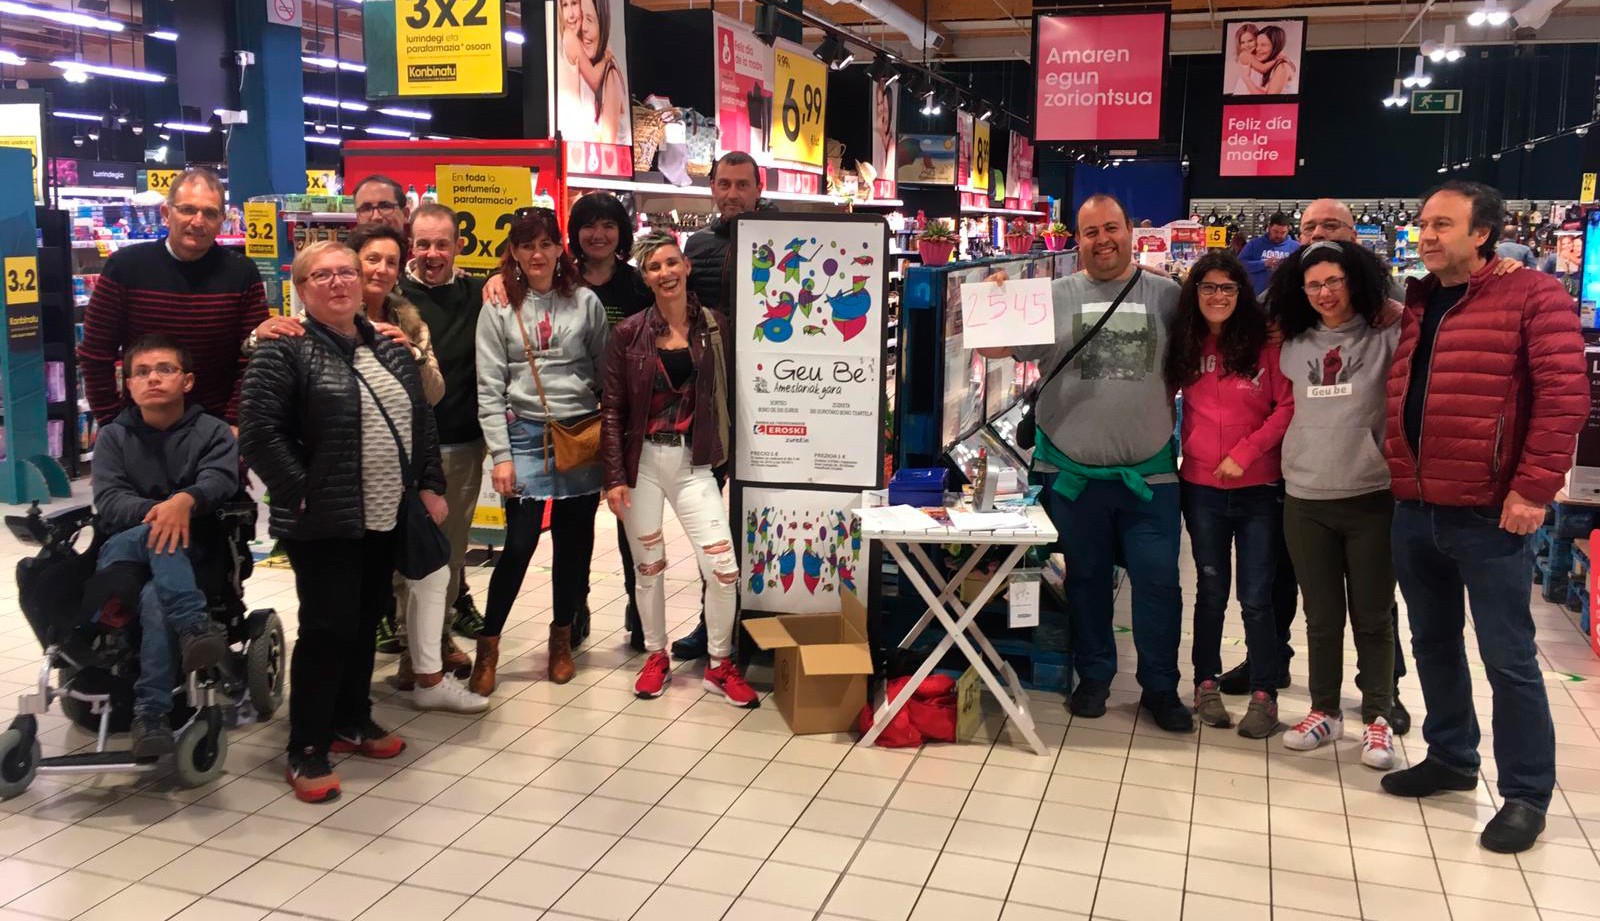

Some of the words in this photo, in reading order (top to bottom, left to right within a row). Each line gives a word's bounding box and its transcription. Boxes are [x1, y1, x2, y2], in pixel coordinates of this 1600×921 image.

[466, 43, 491, 51] osoan
[1045, 46, 1130, 65] Amaren
[409, 66, 456, 77] Konbinatu
[1045, 71, 1099, 90] egun
[1044, 88, 1153, 107] zoriontsua
[1228, 117, 1261, 131] Feliz
[1265, 116, 1292, 130] día
[1227, 133, 1249, 146] de
[1253, 133, 1268, 146] la
[1226, 148, 1279, 161] madre
[465, 173, 486, 182] toda
[8, 268, 37, 293] 3x2
[773, 359, 823, 381] Geu
[1311, 387, 1332, 397] Geu
[1334, 385, 1347, 395] be
[768, 426, 805, 434] EROSKI
